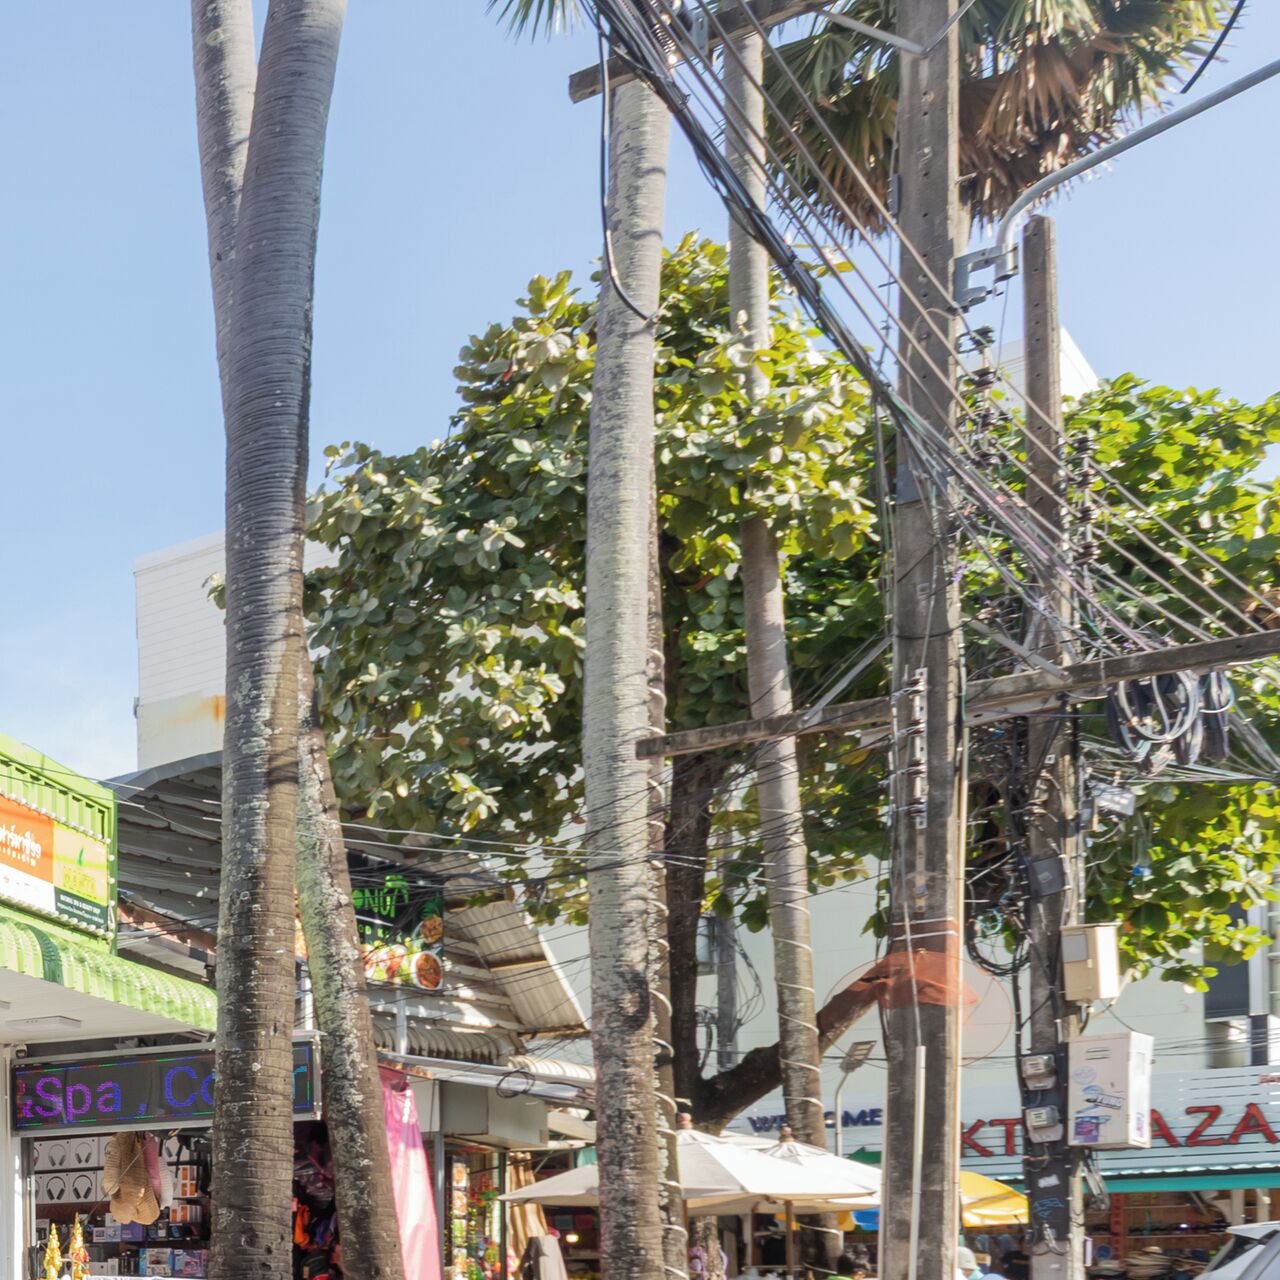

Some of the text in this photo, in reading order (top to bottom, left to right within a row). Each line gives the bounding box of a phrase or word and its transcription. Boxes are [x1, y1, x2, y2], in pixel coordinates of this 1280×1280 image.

[34, 1076, 122, 1123] Spa
[747, 1106, 884, 1134] WEOME
[1150, 1101, 1280, 1149] AZA
